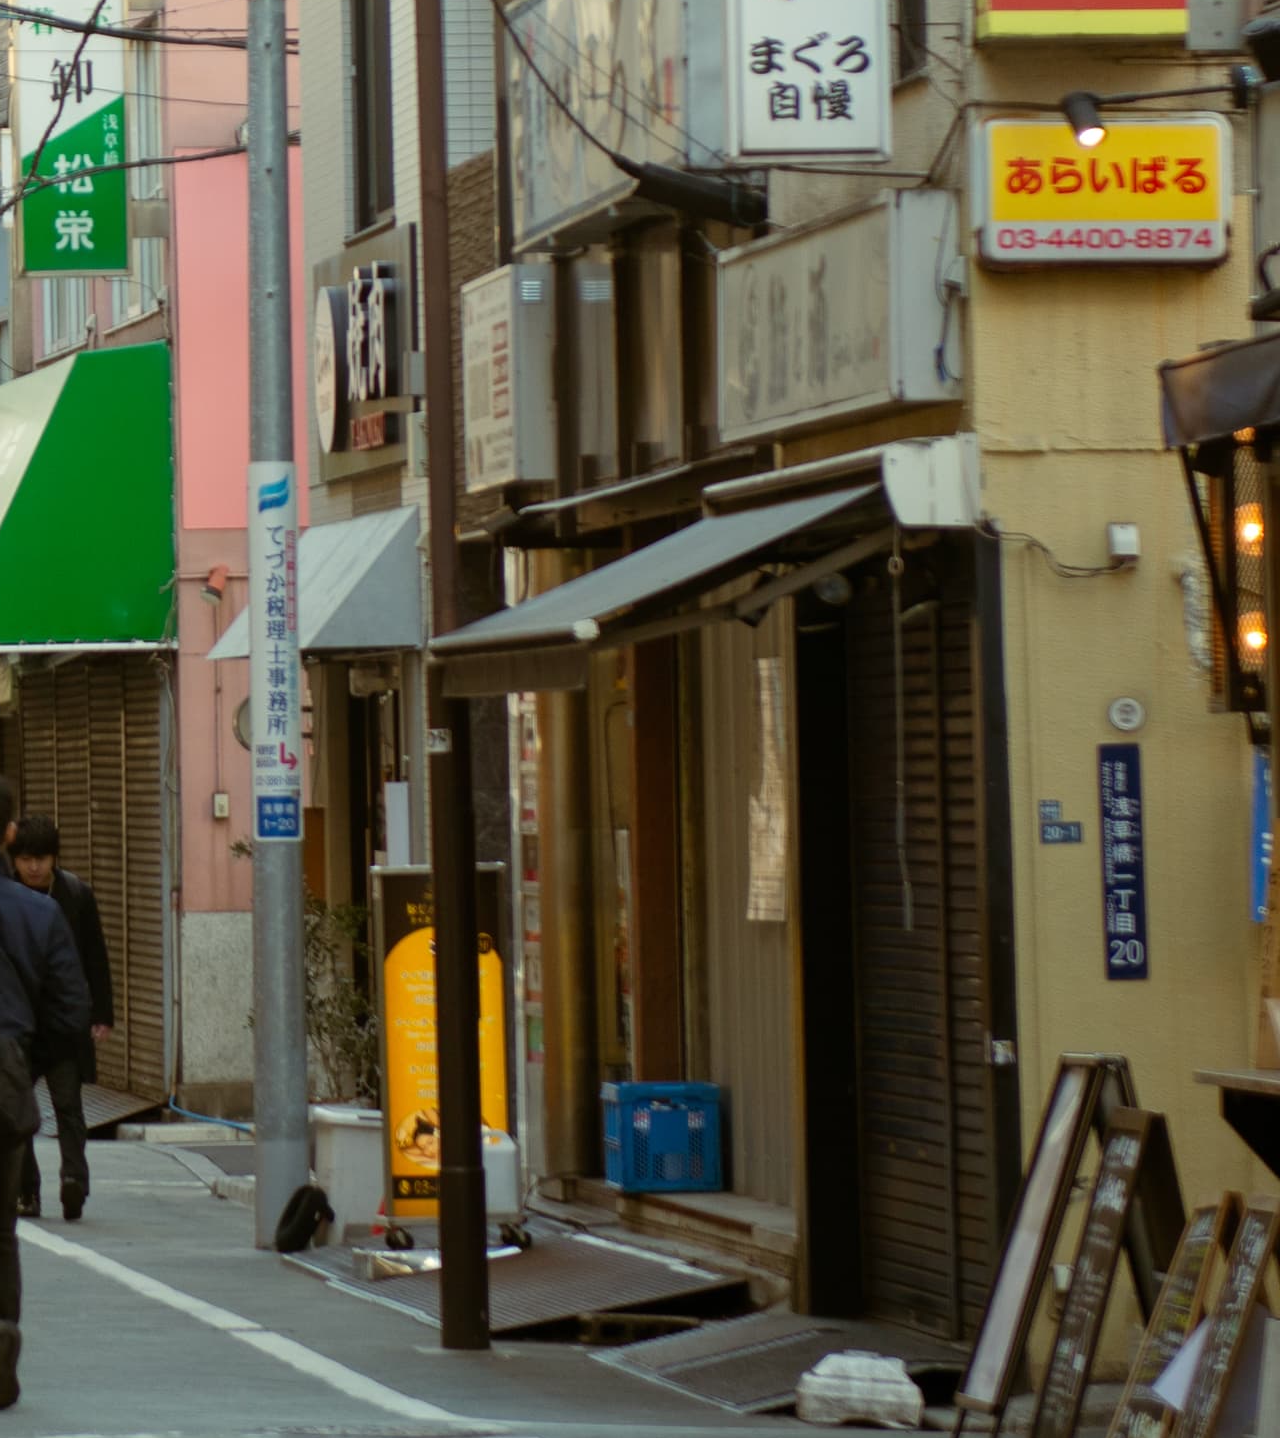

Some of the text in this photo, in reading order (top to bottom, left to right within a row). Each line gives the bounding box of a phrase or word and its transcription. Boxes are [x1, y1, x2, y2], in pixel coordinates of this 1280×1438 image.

[749, 33, 872, 75] まぐろ
[50, 57, 94, 104] 卸
[768, 80, 856, 122] 自慢
[1004, 154, 1208, 196] あらいばる
[53, 153, 95, 252] 松栄
[996, 226, 1214, 252] 03-4400-8874
[265, 525, 288, 737] てづか税理士事務所
[1109, 938, 1145, 966] 20
